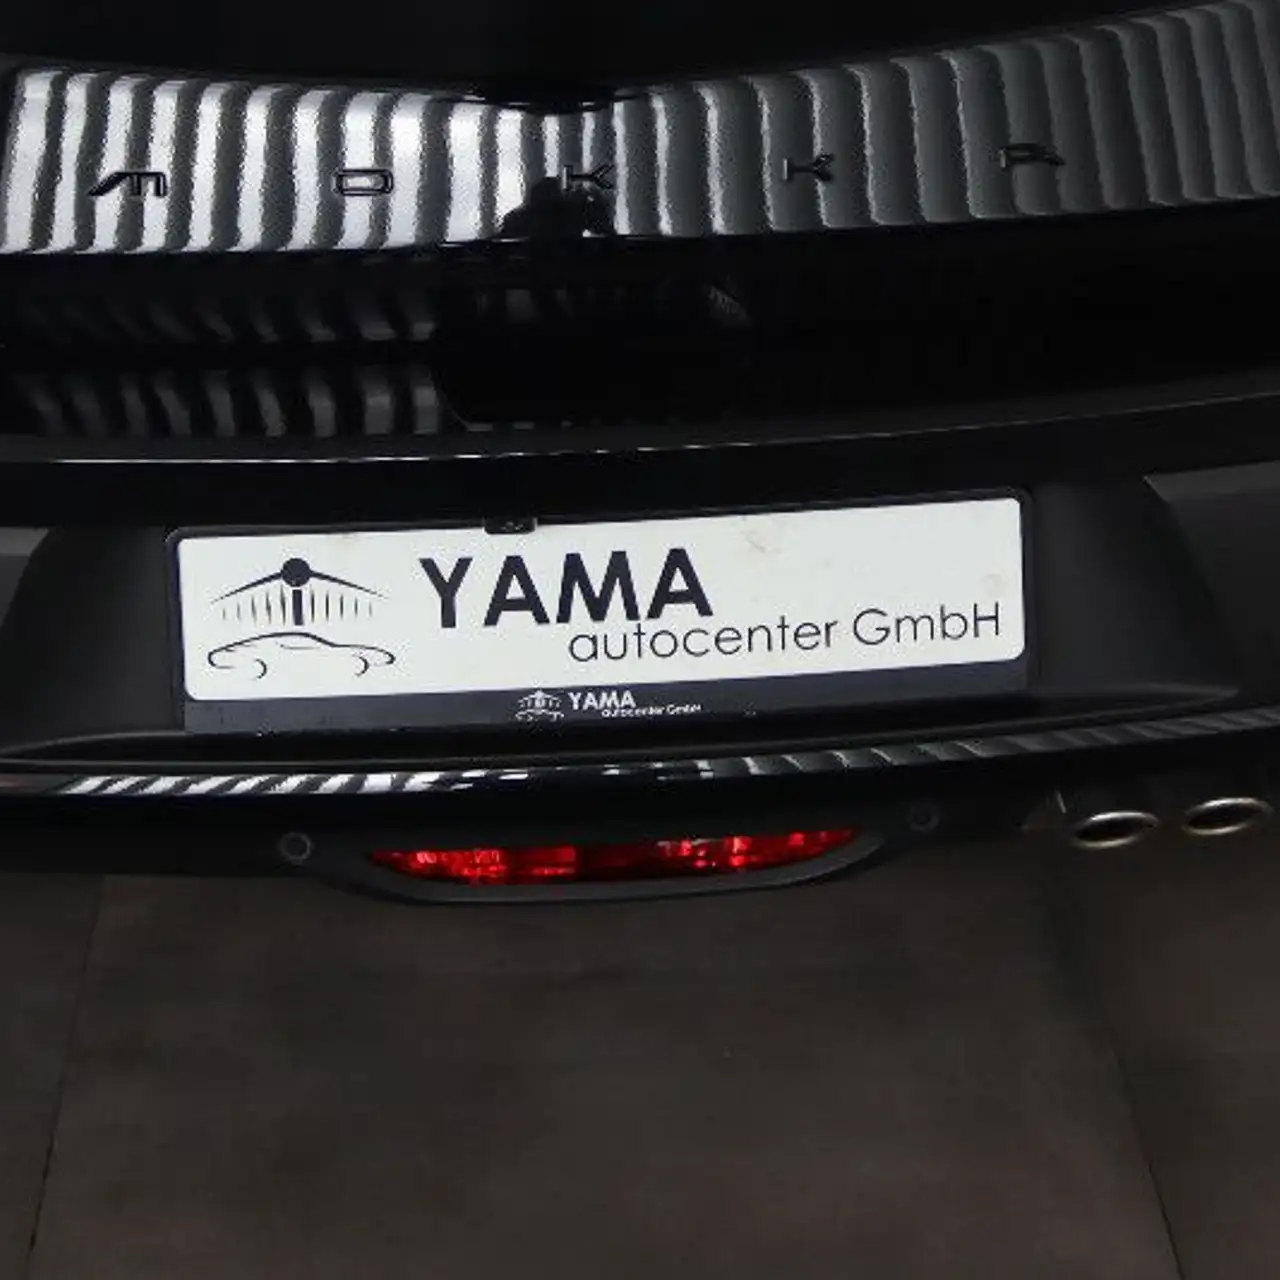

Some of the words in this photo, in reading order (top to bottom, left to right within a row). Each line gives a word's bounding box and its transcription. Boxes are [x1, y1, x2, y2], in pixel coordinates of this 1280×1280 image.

[86, 142, 1066, 198] MOKKA
[418, 548, 714, 628] YAMA
[569, 615, 838, 662] autocenter
[853, 602, 999, 645] GmbH
[568, 690, 636, 710] YAMA
